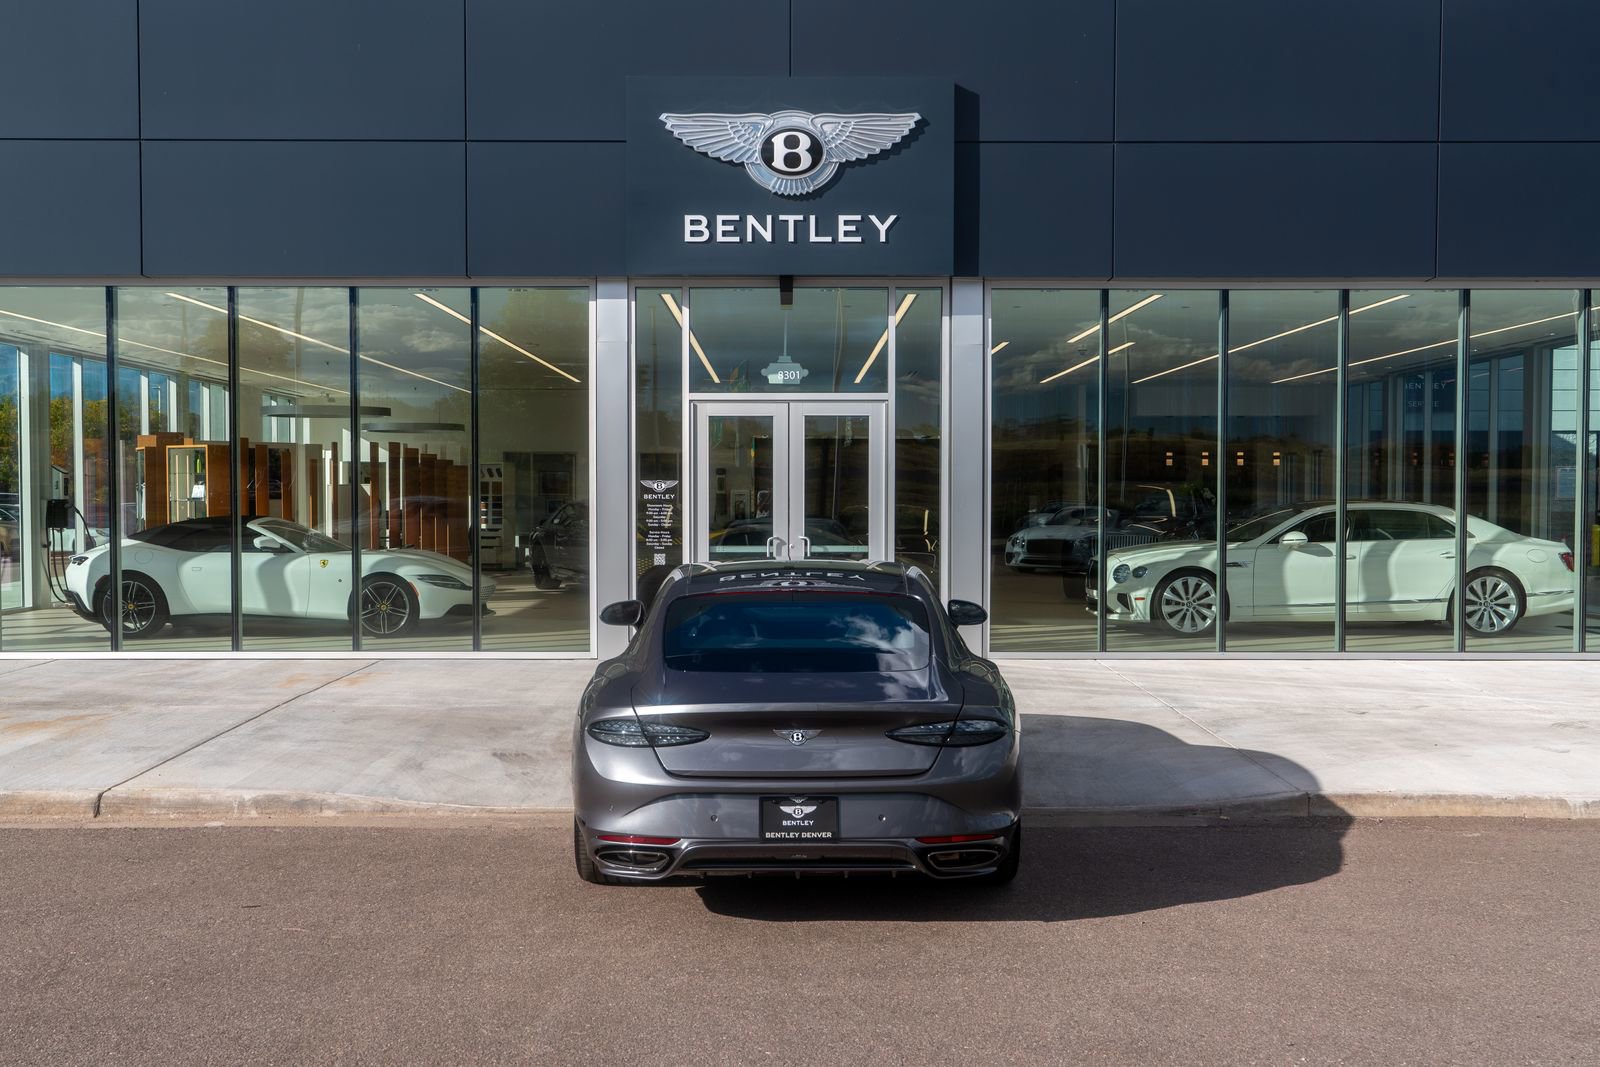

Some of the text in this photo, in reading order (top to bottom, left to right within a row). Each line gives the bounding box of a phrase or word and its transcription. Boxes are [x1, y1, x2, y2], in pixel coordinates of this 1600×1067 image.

[772, 131, 813, 173] B
[684, 214, 898, 243] BENTLEY
[778, 370, 800, 380] 8301
[1405, 382, 1446, 390] ENEY
[793, 732, 803, 742] B
